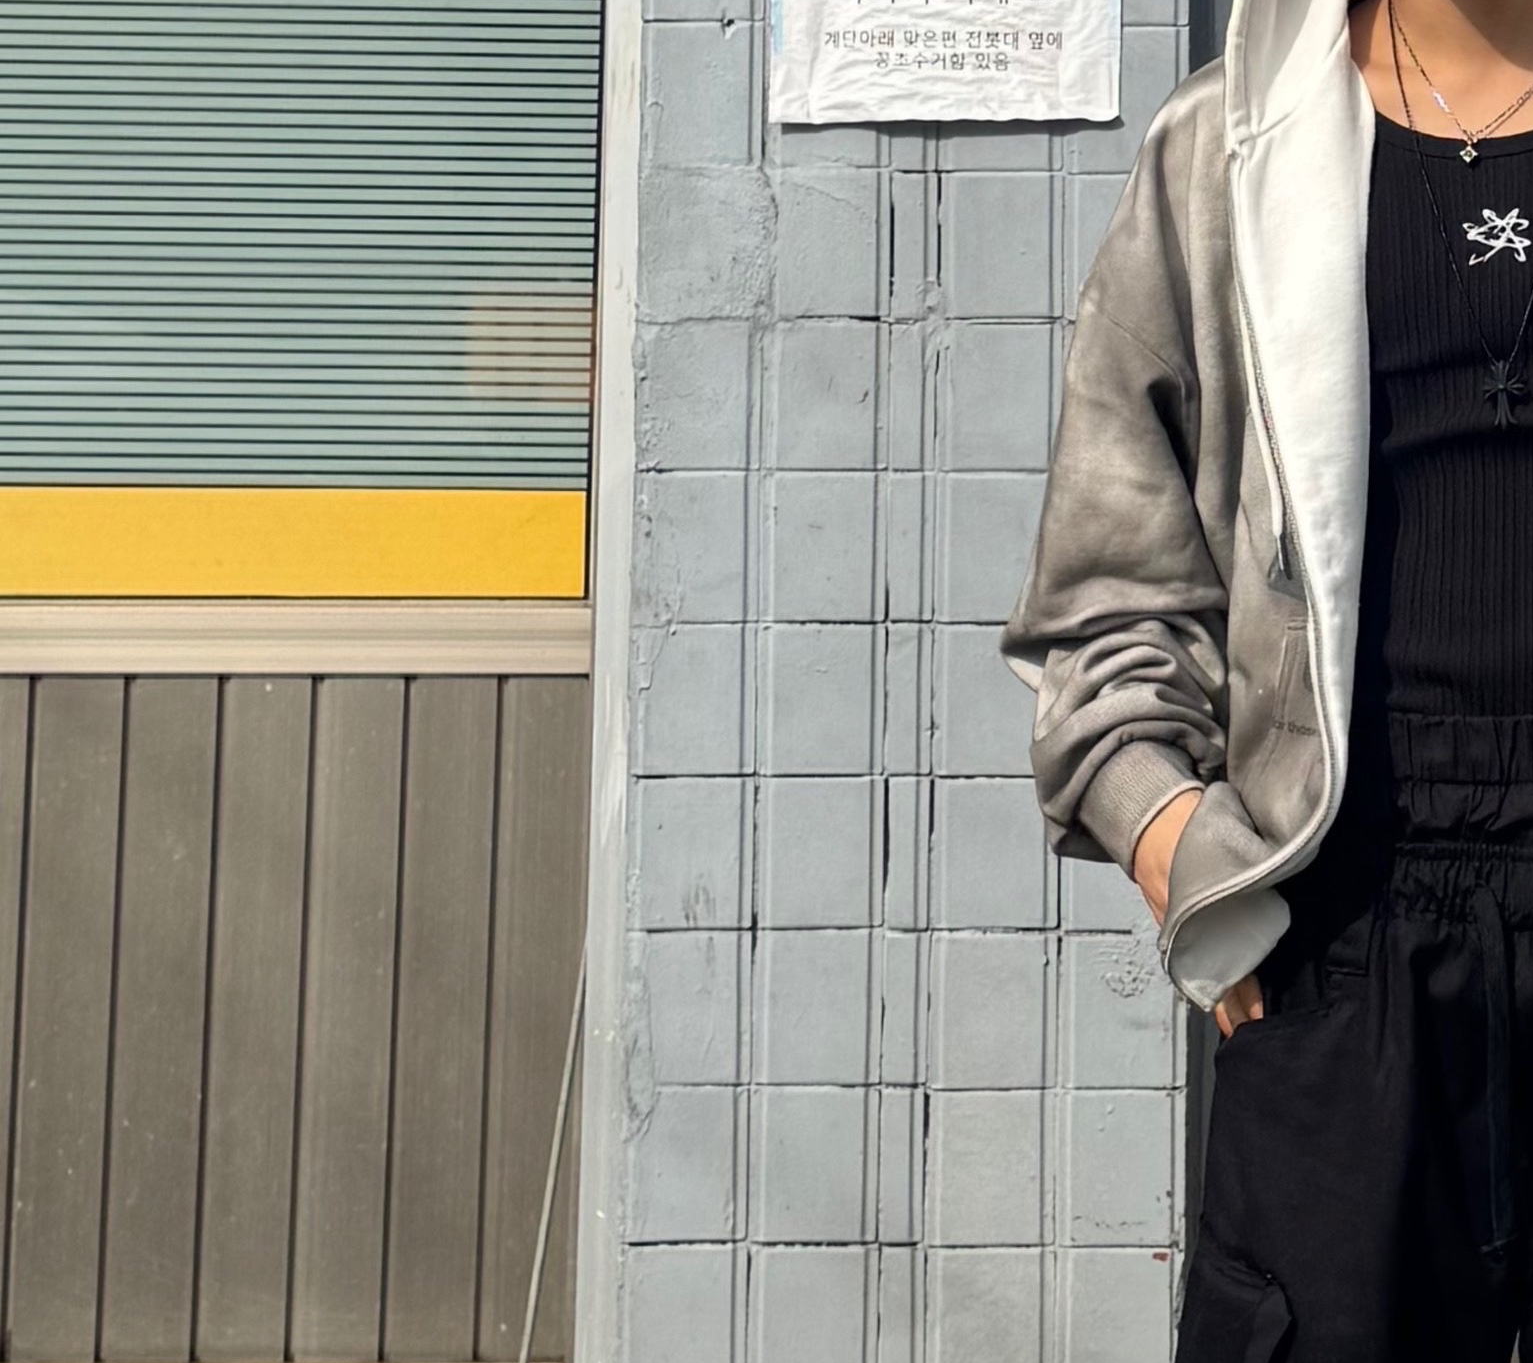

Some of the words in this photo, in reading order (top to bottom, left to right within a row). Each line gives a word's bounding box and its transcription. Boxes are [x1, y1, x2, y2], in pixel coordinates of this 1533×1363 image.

[824, 30, 895, 49] 계단아래
[903, 30, 958, 49] 맞은편
[1029, 31, 1064, 50] 옆에
[975, 52, 1011, 71] 있음
